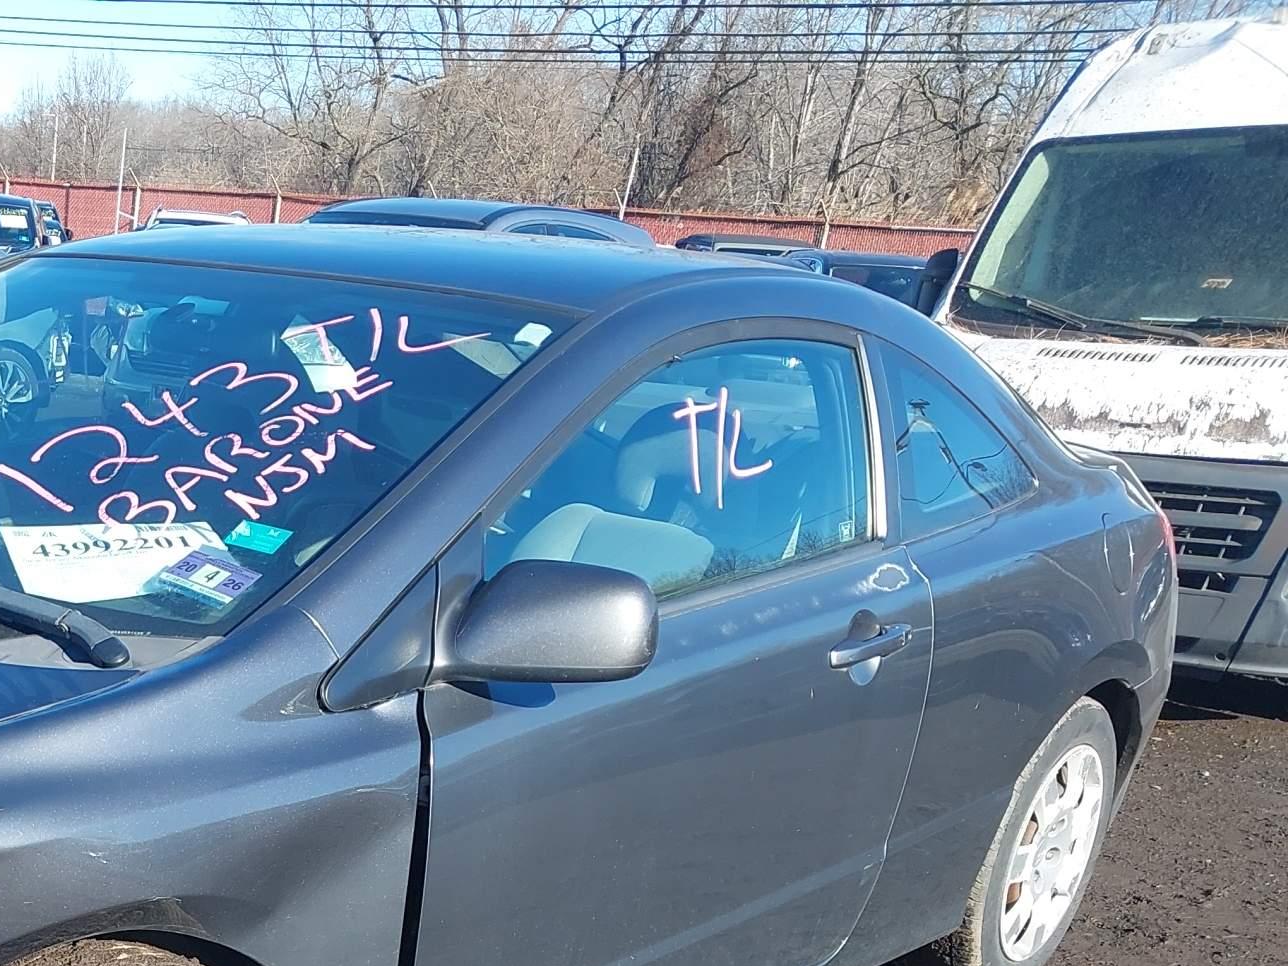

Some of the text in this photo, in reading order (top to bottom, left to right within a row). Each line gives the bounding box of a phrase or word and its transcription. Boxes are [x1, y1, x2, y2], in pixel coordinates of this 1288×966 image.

[97, 366, 394, 534] BARONE
[32, 535, 192, 558] 43992201
[176, 560, 198, 574] 20
[204, 570, 221, 583] 4
[222, 578, 245, 591] 26
